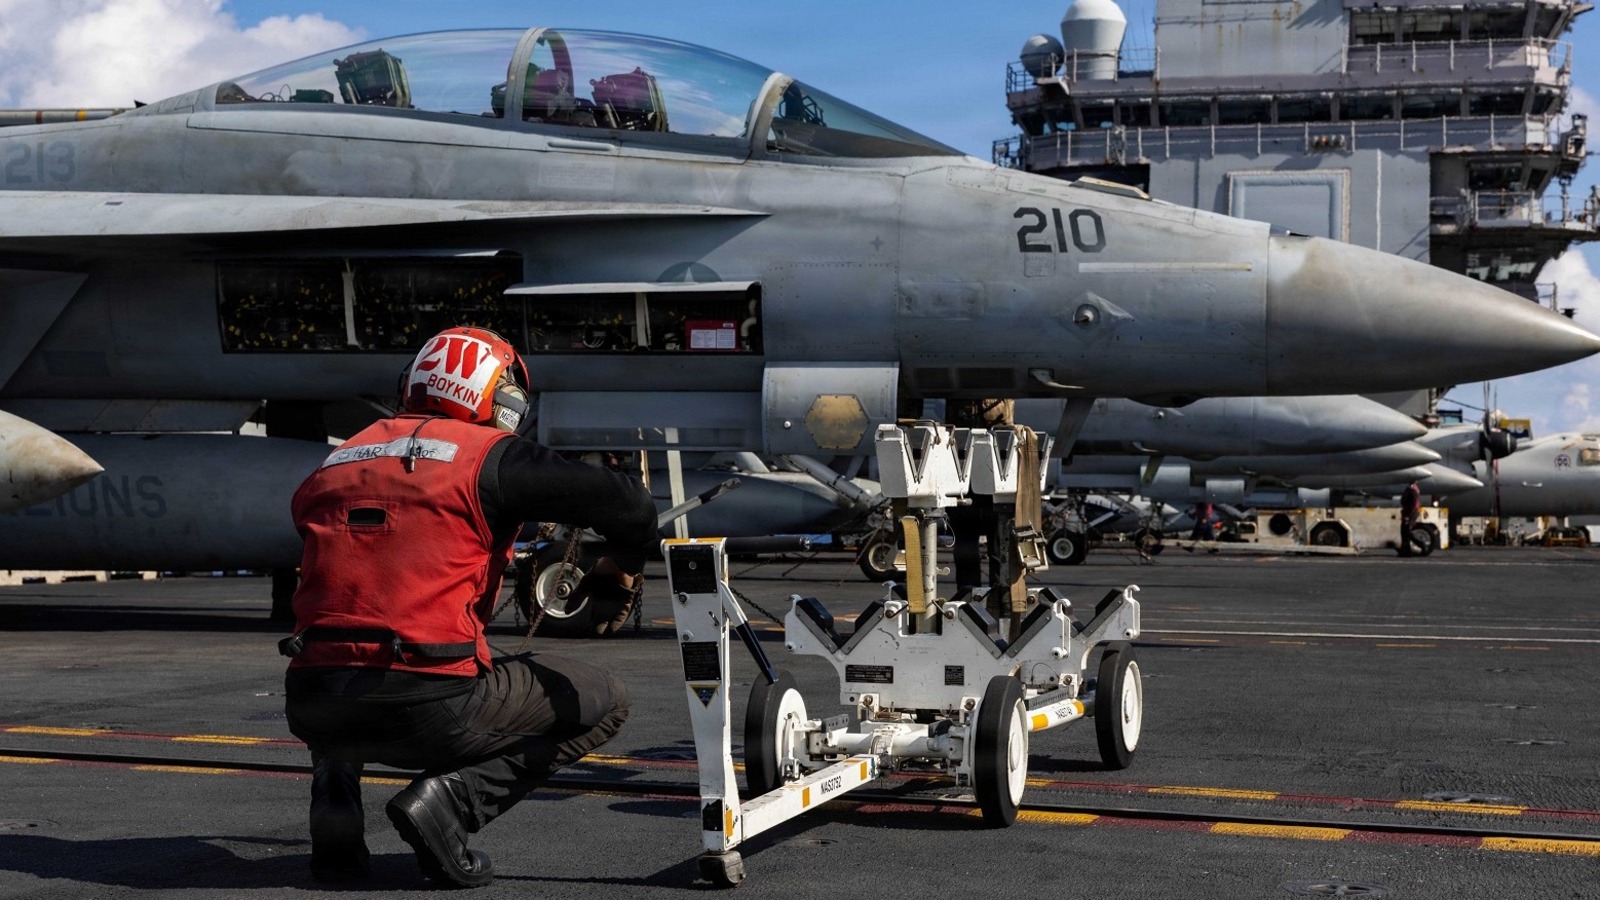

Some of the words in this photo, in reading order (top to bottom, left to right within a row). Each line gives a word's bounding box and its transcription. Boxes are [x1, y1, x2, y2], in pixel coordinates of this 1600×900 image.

[5, 141, 76, 184] 213
[1013, 207, 1107, 253] 210
[427, 373, 480, 406] BOYKIN
